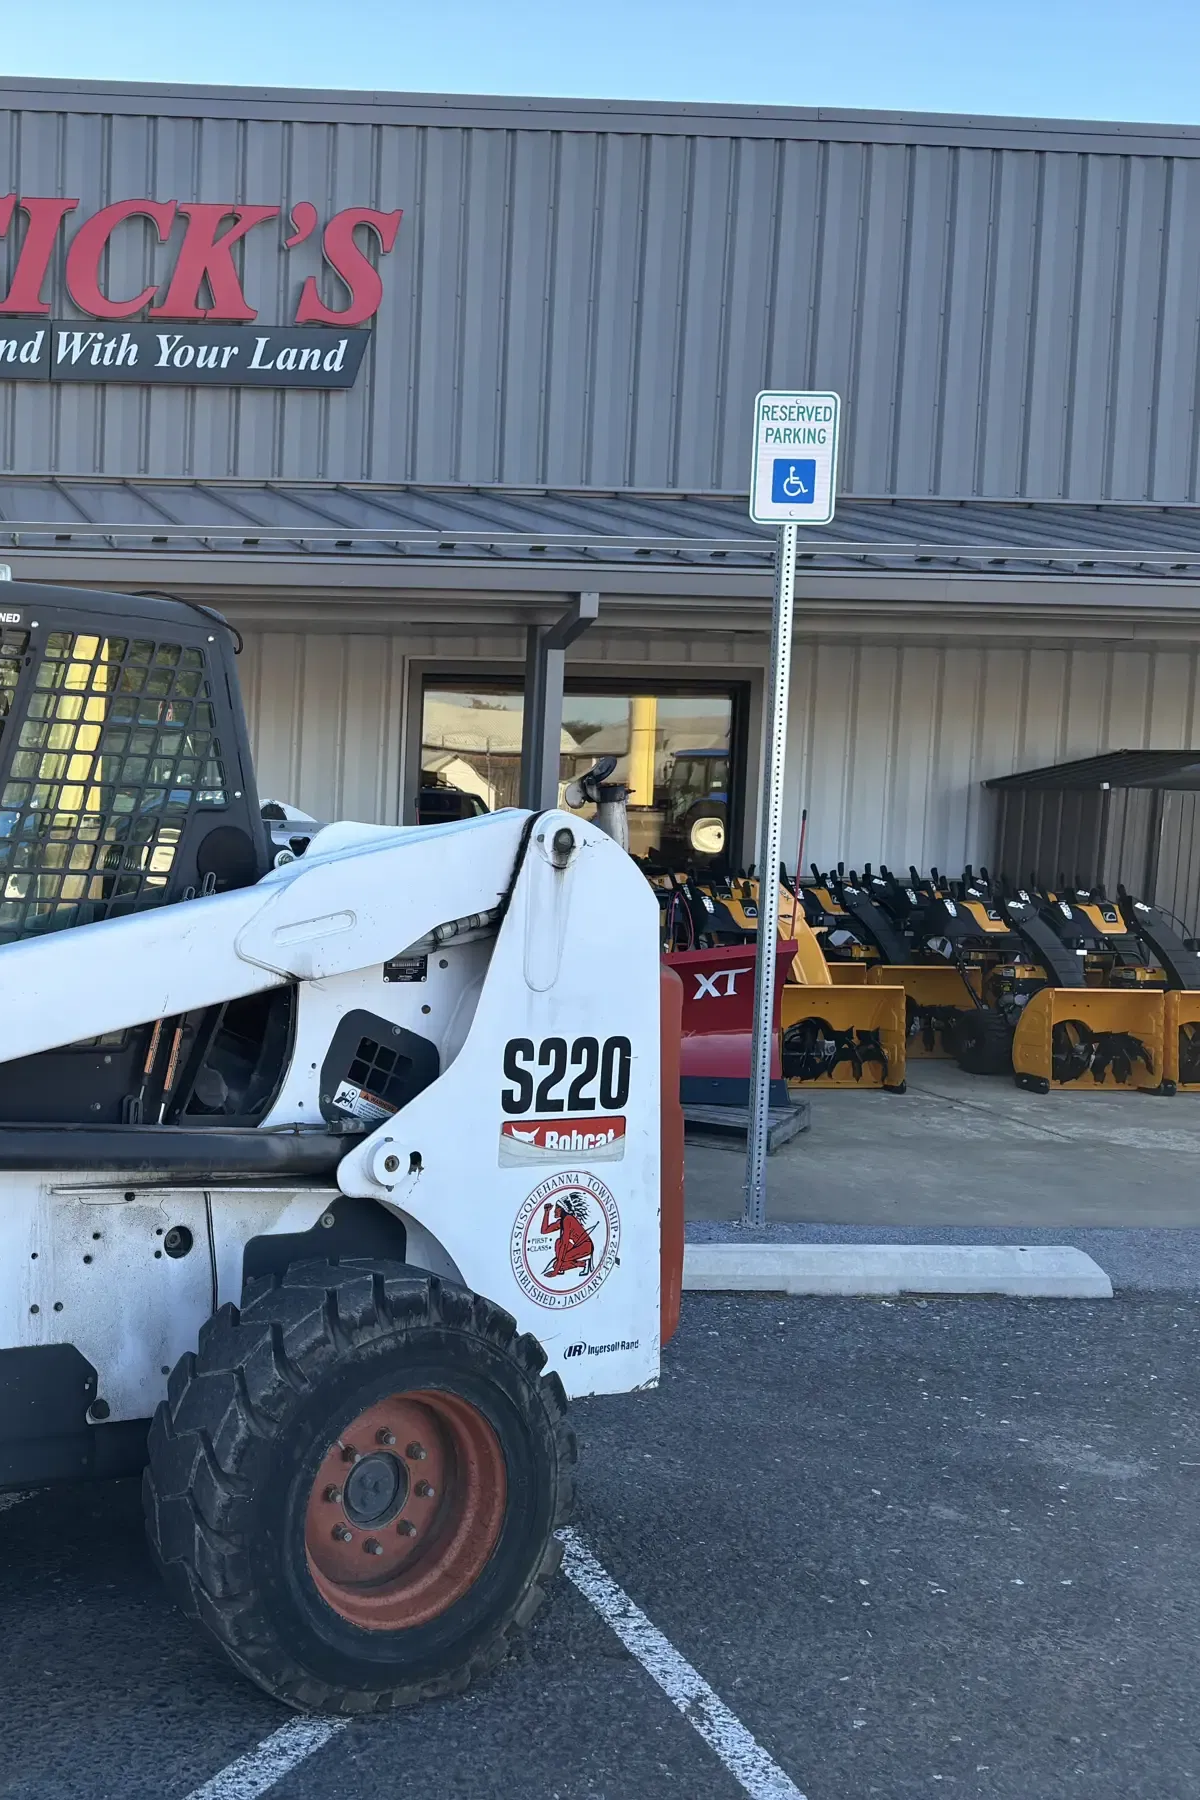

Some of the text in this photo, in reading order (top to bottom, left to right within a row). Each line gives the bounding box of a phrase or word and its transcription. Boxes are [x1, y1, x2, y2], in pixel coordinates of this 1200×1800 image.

[56, 331, 140, 366] With
[154, 334, 239, 369] Your
[247, 337, 348, 372] Land
[761, 405, 833, 422] RESERVED
[765, 427, 827, 444] PARKING
[692, 967, 753, 1000] XT
[501, 1036, 632, 1114] S220
[514, 1173, 580, 1240] SUSQUEHANNA
[586, 1177, 619, 1232] TOWNSHIP
[530, 1244, 549, 1252] CLASS
[531, 1237, 548, 1245] FIRST
[512, 1247, 557, 1307] ESTABLISHED
[562, 1241, 618, 1307] JANUARY 1952
